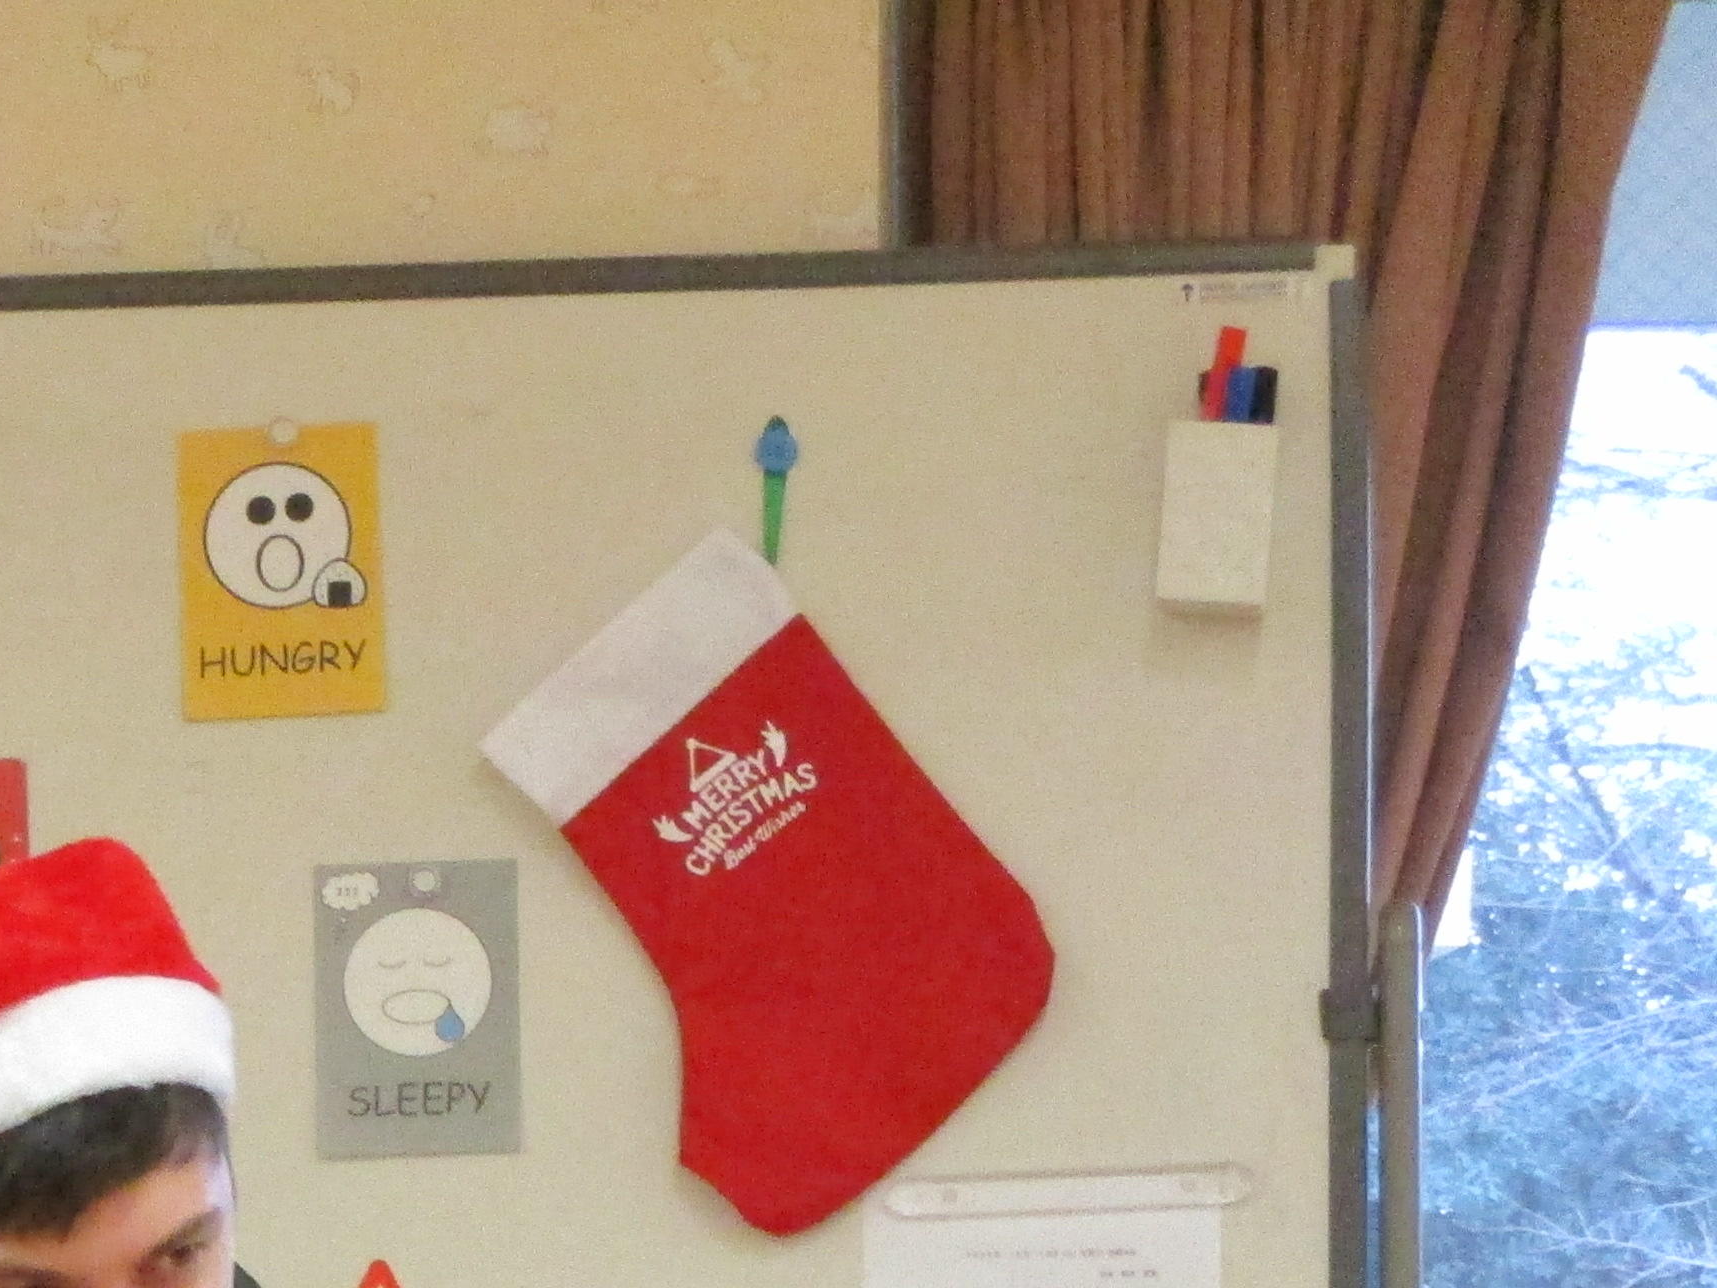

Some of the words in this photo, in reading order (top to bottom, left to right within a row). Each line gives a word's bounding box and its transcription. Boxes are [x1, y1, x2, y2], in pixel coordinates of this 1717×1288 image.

[199, 638, 367, 678] HUNGRY
[680, 748, 767, 831] MERRY
[684, 761, 817, 876] CHRISTMAS
[348, 1081, 491, 1117] SLEEPY
